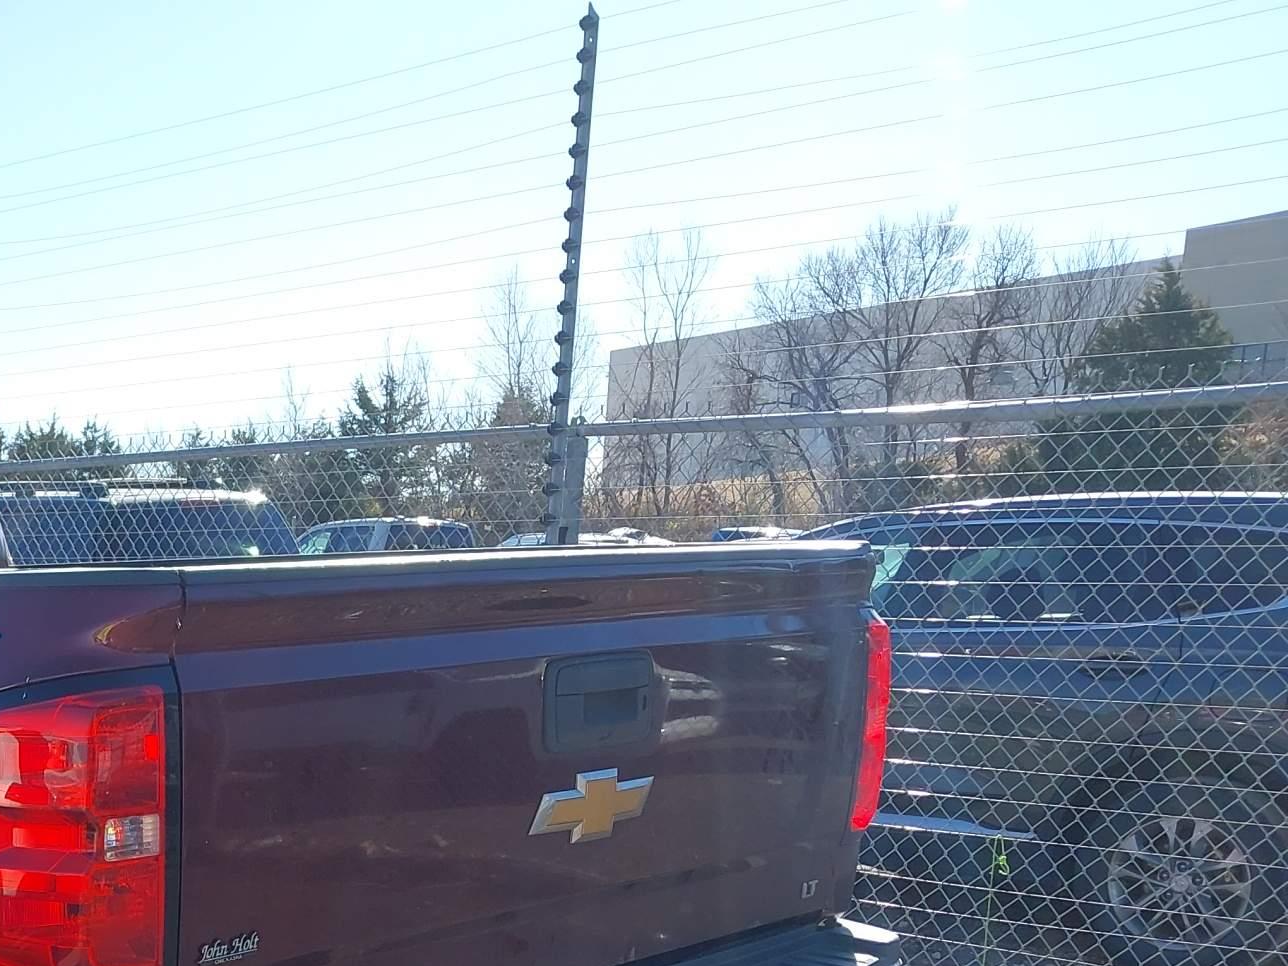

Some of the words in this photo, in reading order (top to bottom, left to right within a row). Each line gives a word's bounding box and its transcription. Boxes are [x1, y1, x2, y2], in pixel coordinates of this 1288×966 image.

[801, 879, 820, 899] LT
[199, 939, 228, 963] John
[230, 931, 260, 954] Holt
